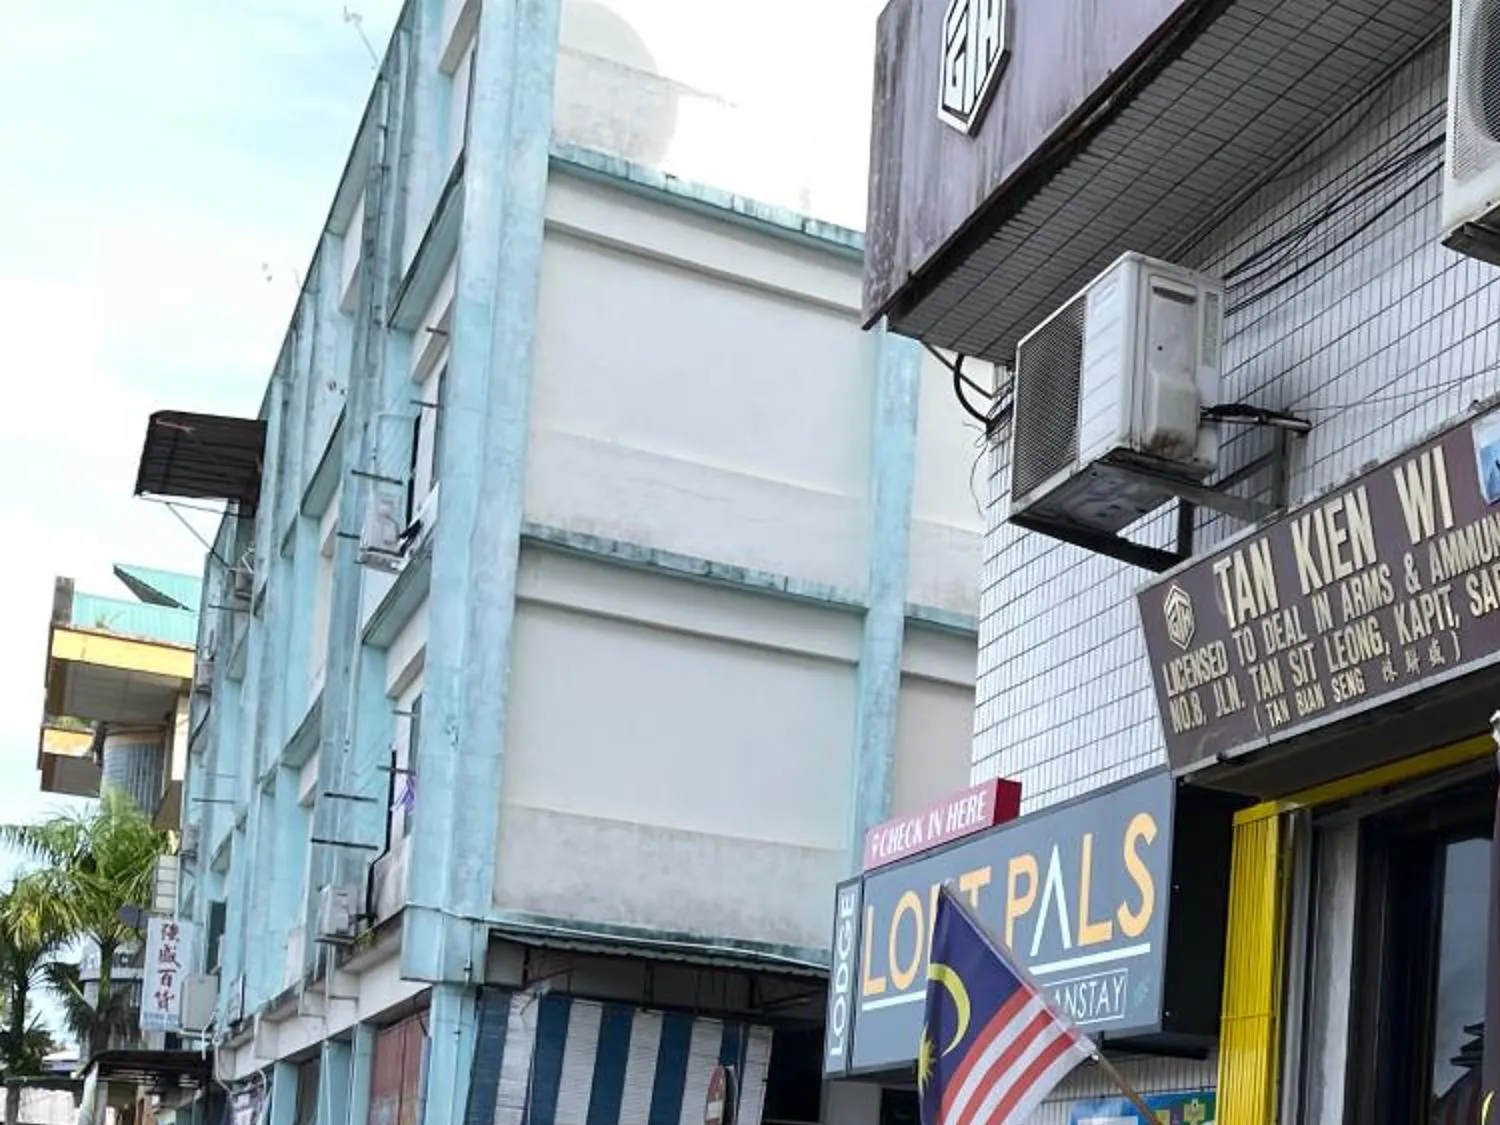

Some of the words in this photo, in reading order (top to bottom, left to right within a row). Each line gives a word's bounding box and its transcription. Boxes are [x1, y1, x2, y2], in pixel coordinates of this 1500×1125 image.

[1213, 537, 1279, 629] TAN
[1290, 485, 1377, 595] KIEN
[1394, 446, 1453, 544] WI
[1162, 640, 1229, 697] LICENSED
[1232, 626, 1257, 666] TO
[1261, 606, 1307, 655] DEAL
[1311, 592, 1334, 633] IN
[1341, 564, 1394, 622] ARMS
[1403, 552, 1422, 594] &
[1213, 675, 1246, 717] JLN.
[1248, 658, 1285, 701] TAN
[1289, 642, 1317, 686] SIT
[1323, 616, 1391, 673] LEONG,
[1394, 585, 1461, 645] KAPIT,
[1332, 667, 1367, 703] SENG
[880, 822, 923, 857] CHECK
[927, 808, 944, 840] IN
[946, 790, 987, 829] HERE
[1005, 813, 1157, 956] PALS
[830, 892, 856, 1056] LODGE
